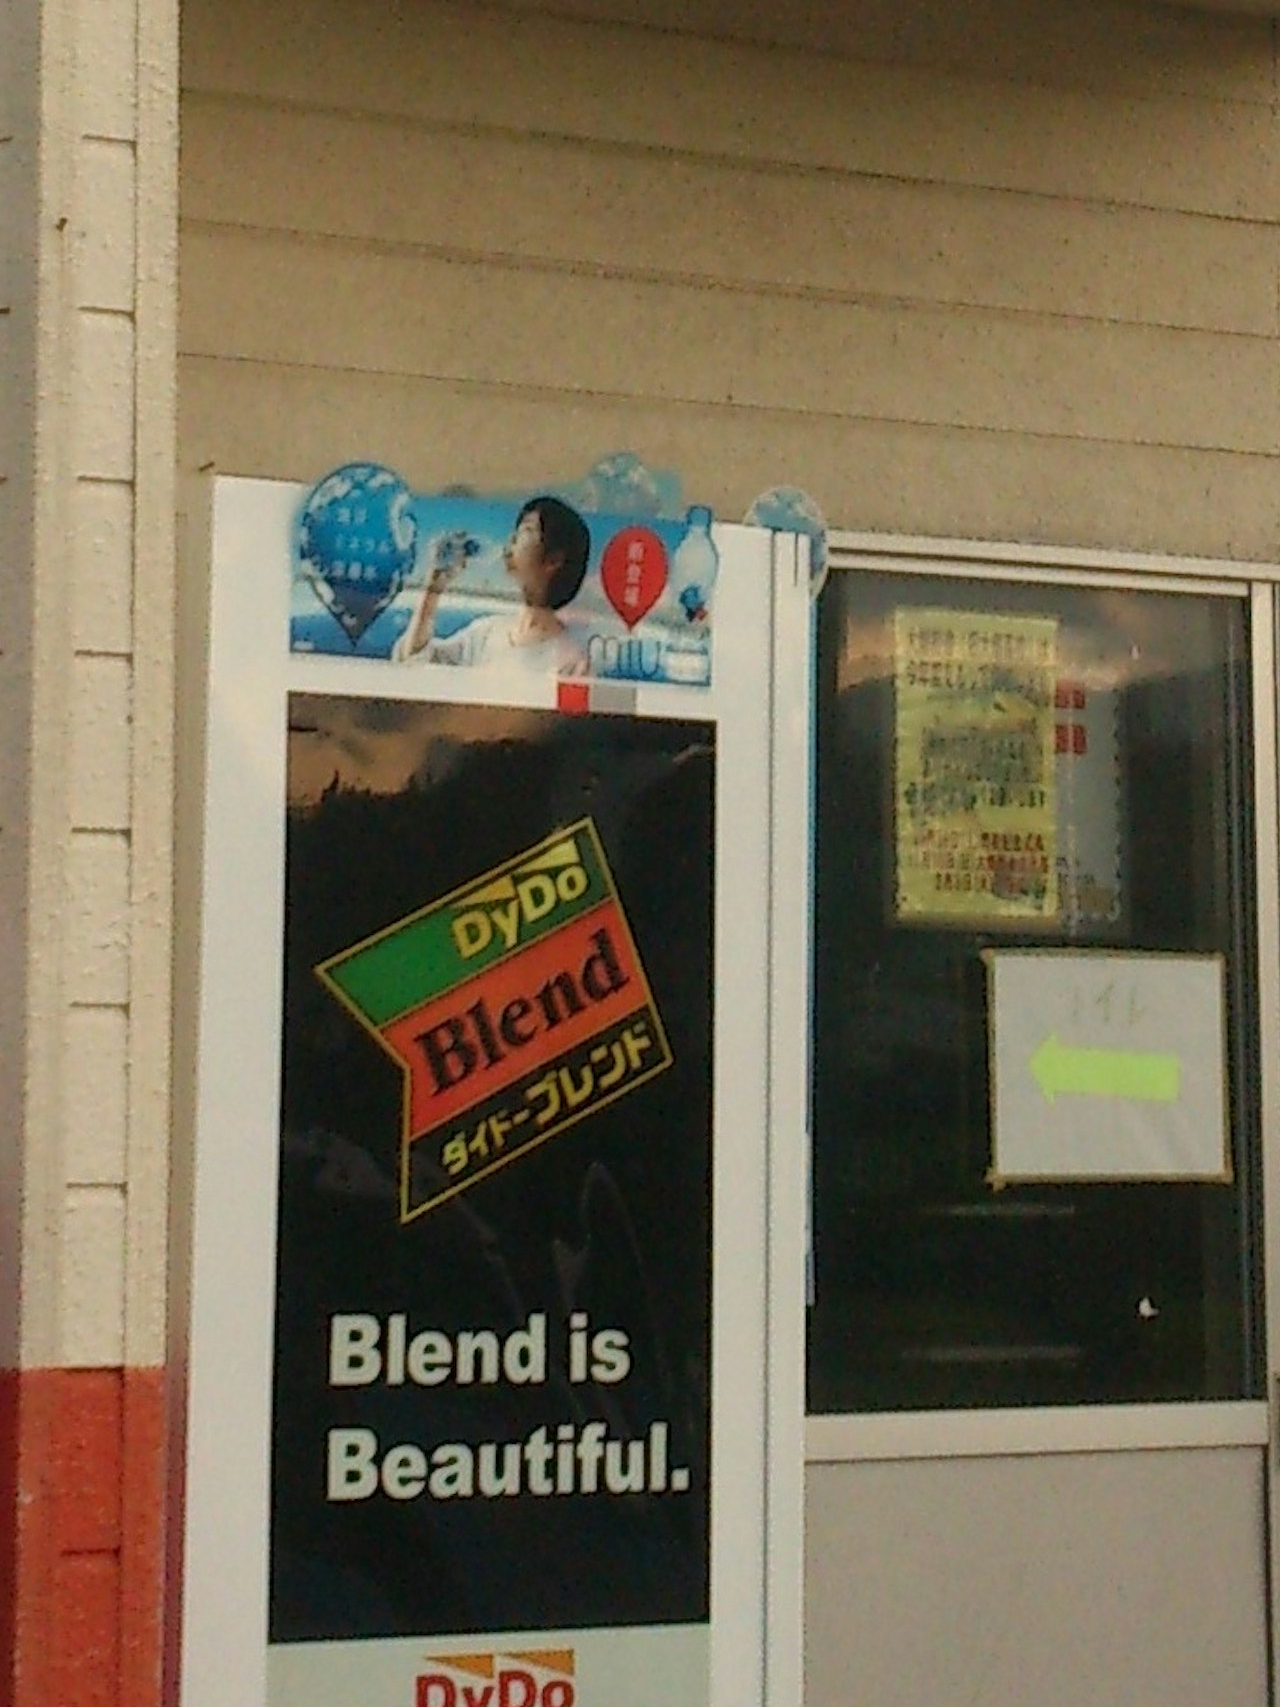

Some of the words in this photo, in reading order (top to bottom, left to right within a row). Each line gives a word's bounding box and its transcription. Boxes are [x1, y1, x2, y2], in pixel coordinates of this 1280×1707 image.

[451, 864, 589, 960] DyDo
[414, 927, 631, 1098] Blend
[440, 1020, 653, 1177] ダイドーブレンド
[327, 1312, 548, 1387] Blend
[568, 1312, 632, 1385] is
[325, 1421, 691, 1503] Beautiful.
